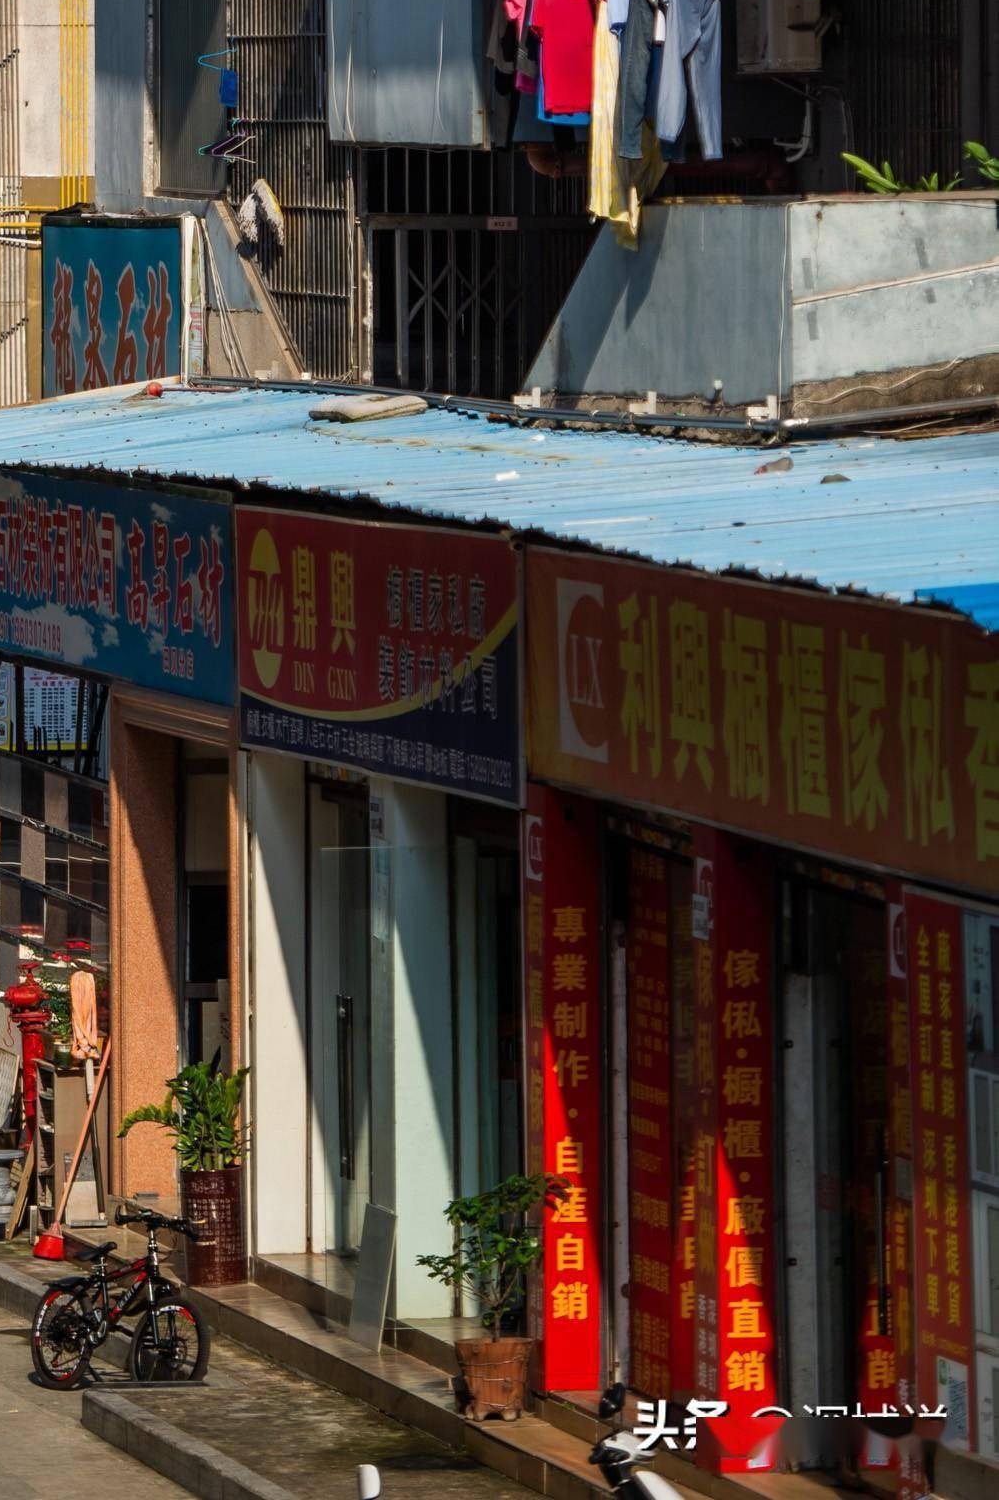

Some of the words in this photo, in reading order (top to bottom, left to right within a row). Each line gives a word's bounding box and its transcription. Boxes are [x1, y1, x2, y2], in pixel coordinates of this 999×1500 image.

[50, 258, 174, 394] 龍泉石材
[293, 545, 356, 657] 鼎興
[294, 661, 315, 693] DIN
[328, 666, 357, 701] GXIN
[570, 632, 605, 710] LX
